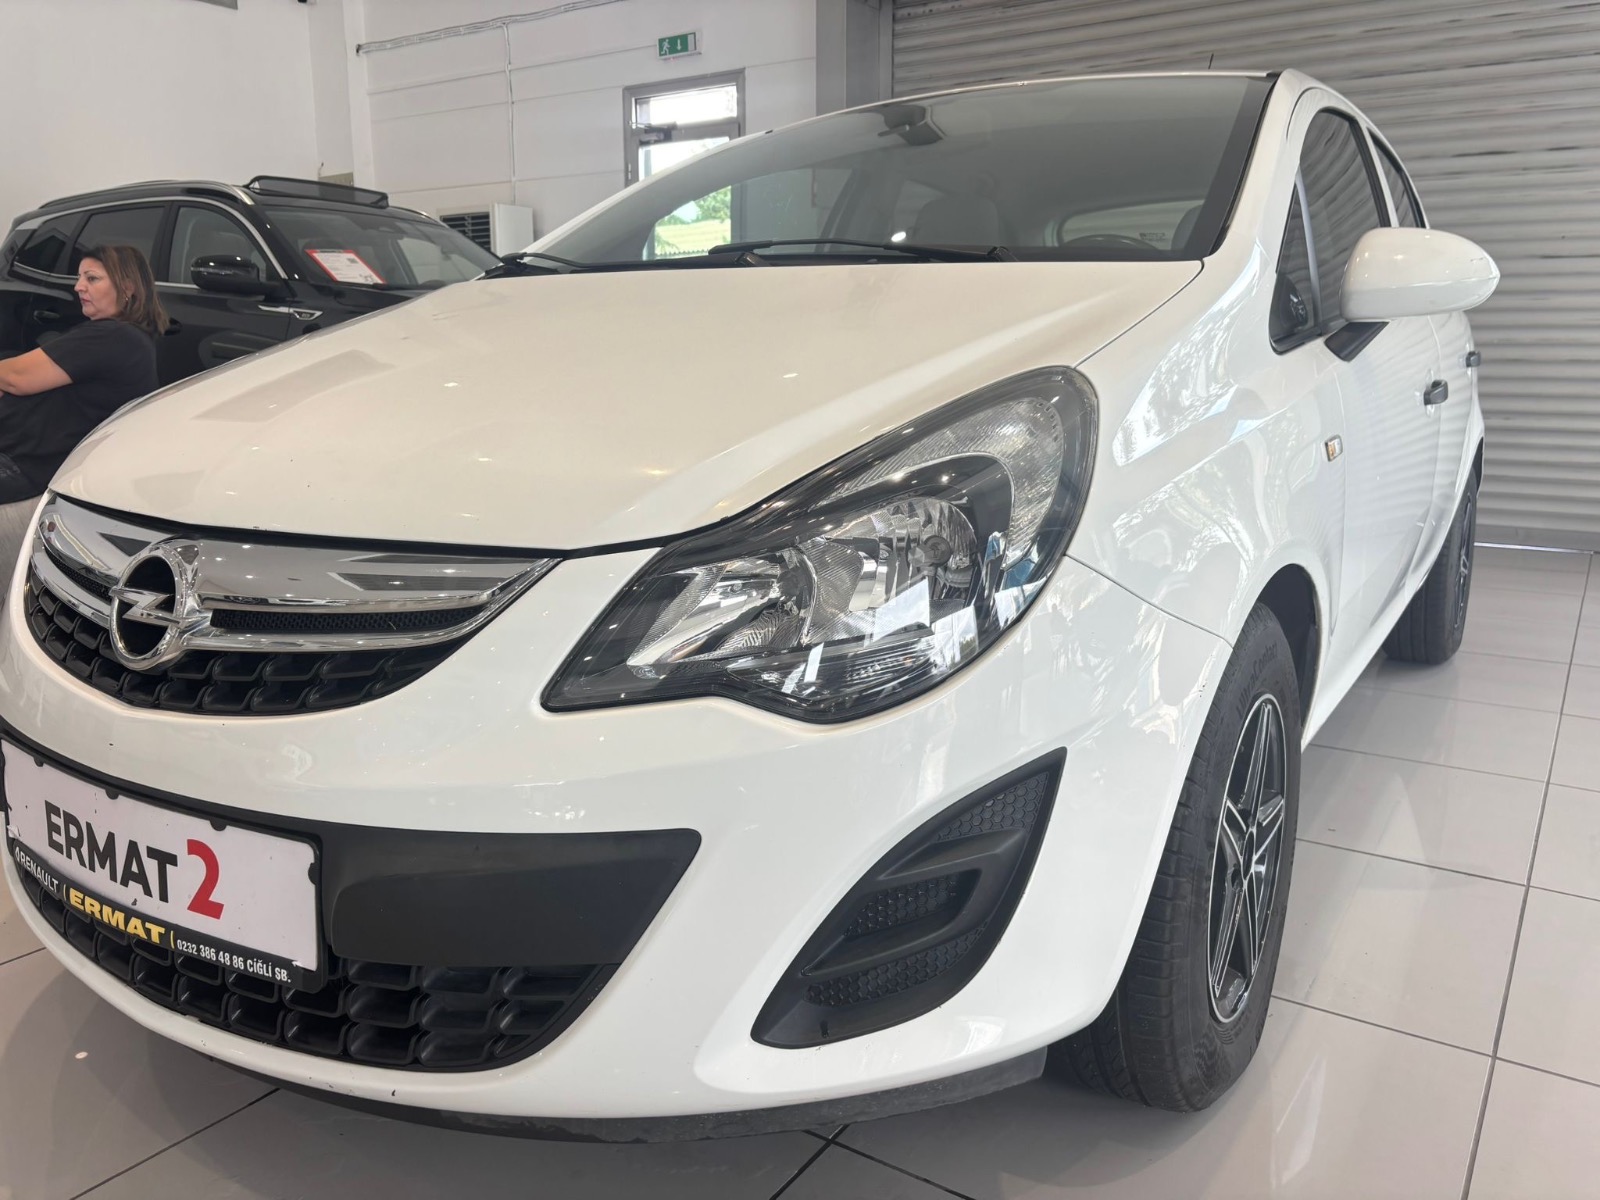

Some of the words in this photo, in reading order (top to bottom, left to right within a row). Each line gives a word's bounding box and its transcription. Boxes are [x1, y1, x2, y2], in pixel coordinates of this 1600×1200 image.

[20, 851, 59, 893] RENAULT
[69, 887, 165, 944] ERMAT
[177, 939, 198, 955] 0232
[199, 945, 216, 961] 386
[218, 951, 231, 966] 48
[232, 955, 245, 970] 86
[45, 800, 178, 903] ERMAT
[187, 838, 225, 920] 2
